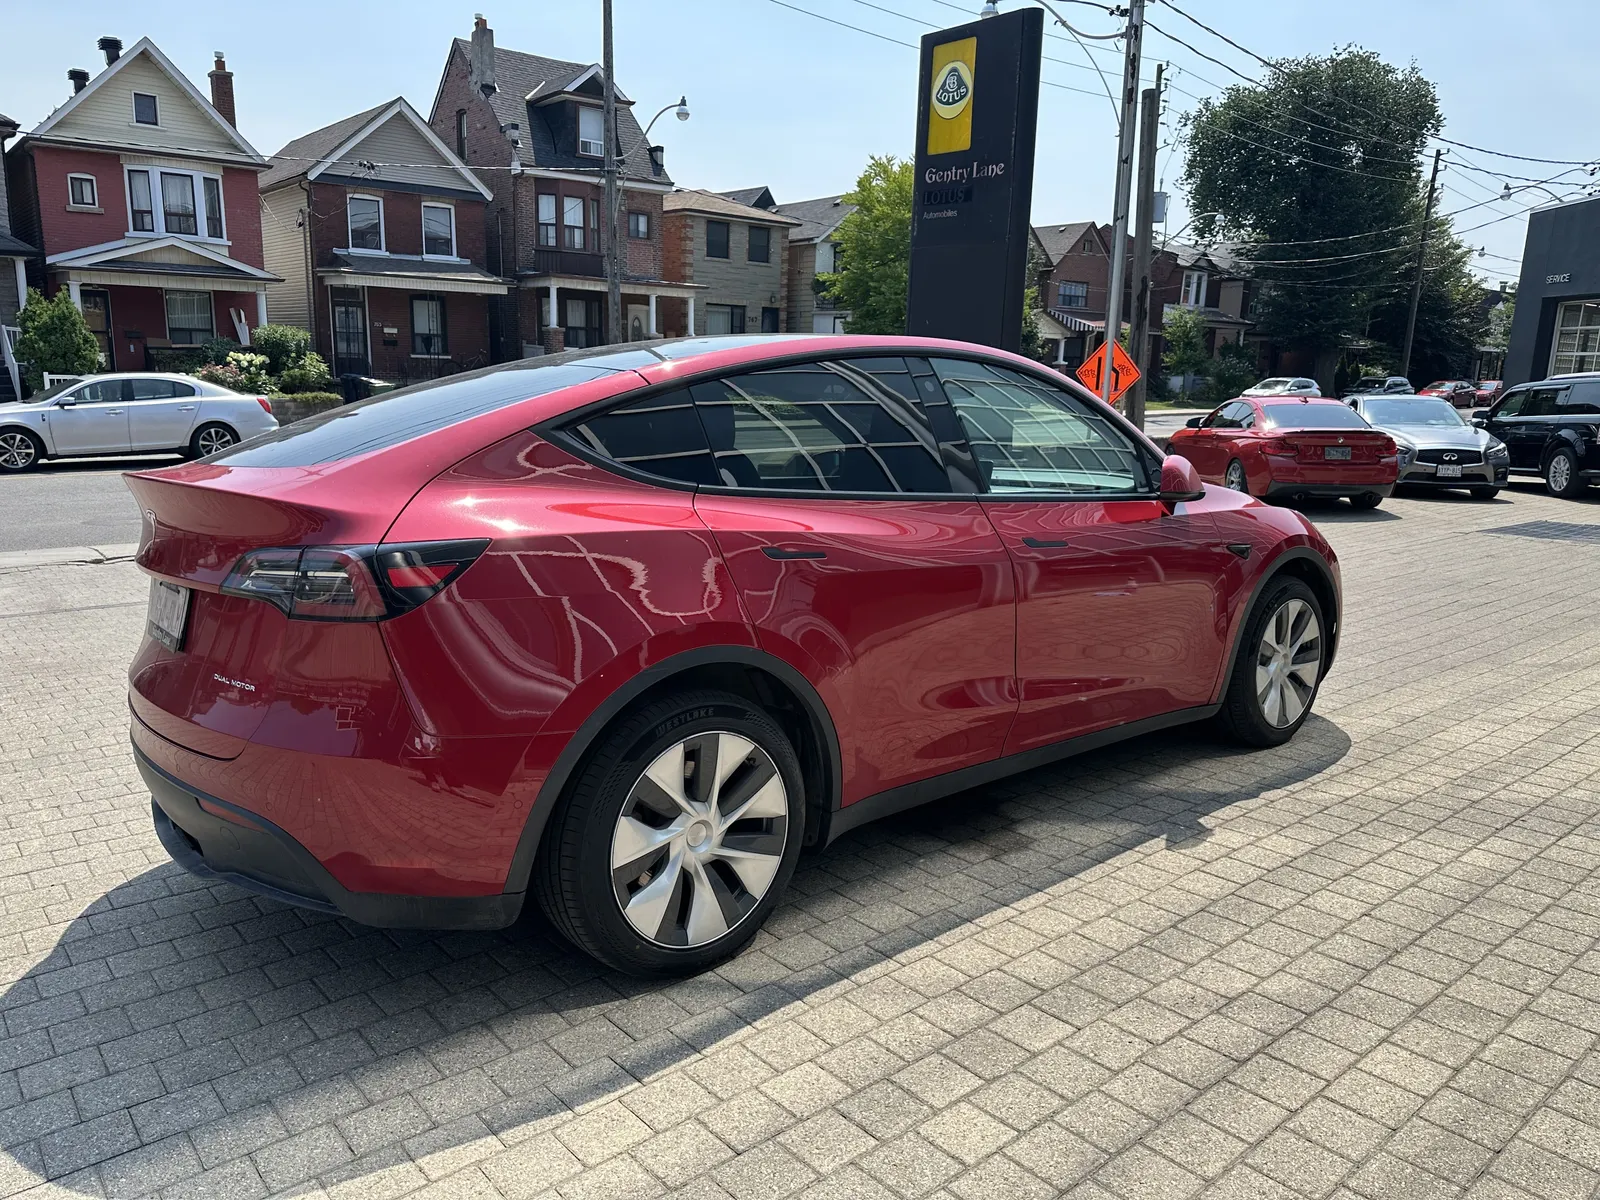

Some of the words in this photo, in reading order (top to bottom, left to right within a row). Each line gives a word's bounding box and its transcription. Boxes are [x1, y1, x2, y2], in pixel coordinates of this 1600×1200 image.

[937, 86, 967, 102] LOTUS
[925, 167, 970, 184] Gentry
[973, 161, 1005, 180] Lane
[924, 188, 965, 205] LOTUS
[923, 209, 958, 220] Automobiles
[1546, 273, 1571, 284] SERVICE
[213, 673, 230, 684] DUAL
[231, 679, 256, 692] MOTOR
[655, 707, 715, 738] WESTLAKE
